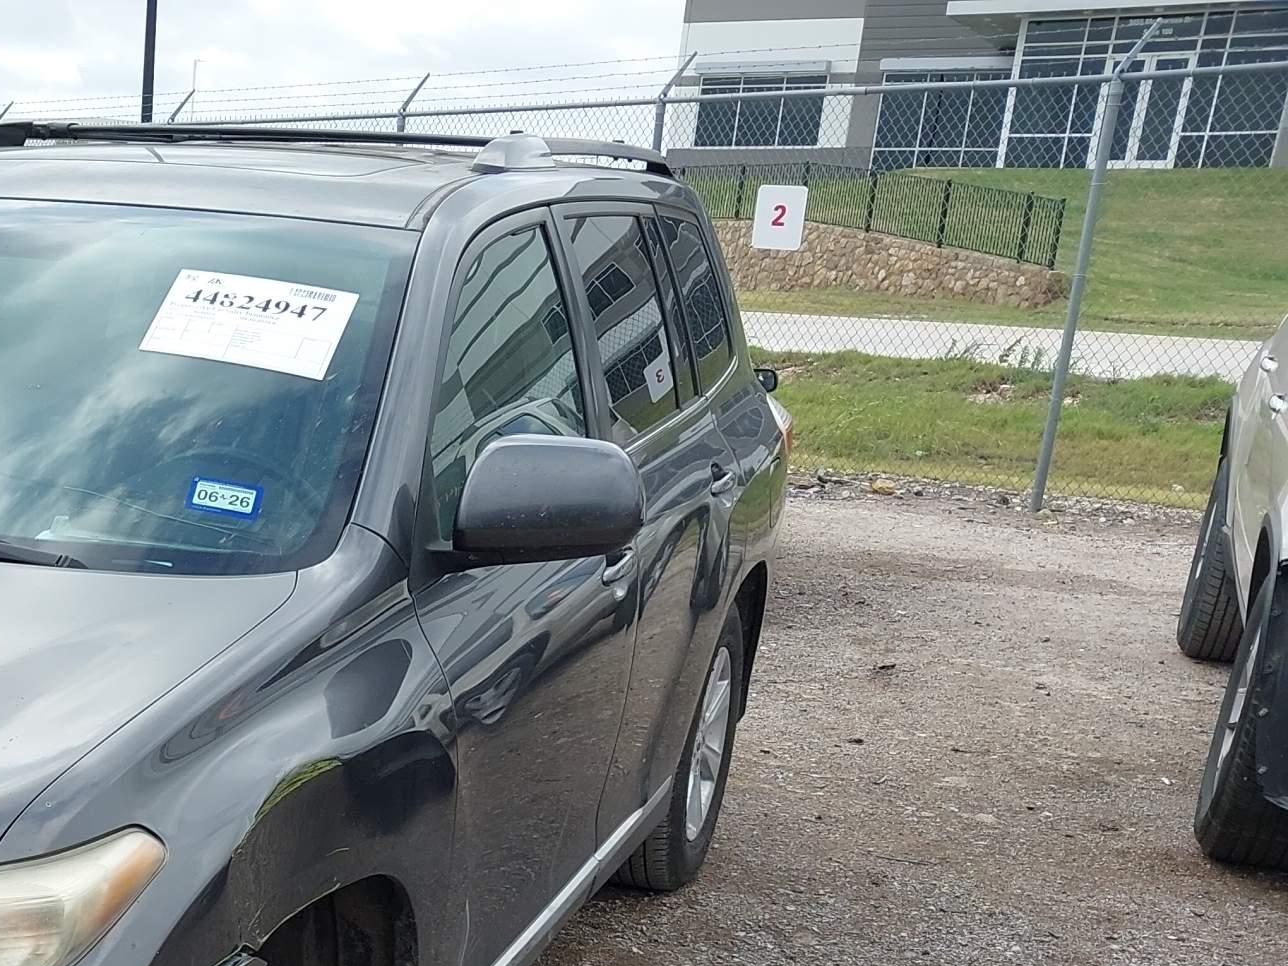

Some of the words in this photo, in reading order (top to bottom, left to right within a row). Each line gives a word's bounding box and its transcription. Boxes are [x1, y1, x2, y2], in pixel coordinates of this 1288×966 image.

[771, 204, 787, 227] 2
[185, 289, 328, 321] 44824947
[197, 489, 219, 503] 06
[228, 494, 251, 508] 26
